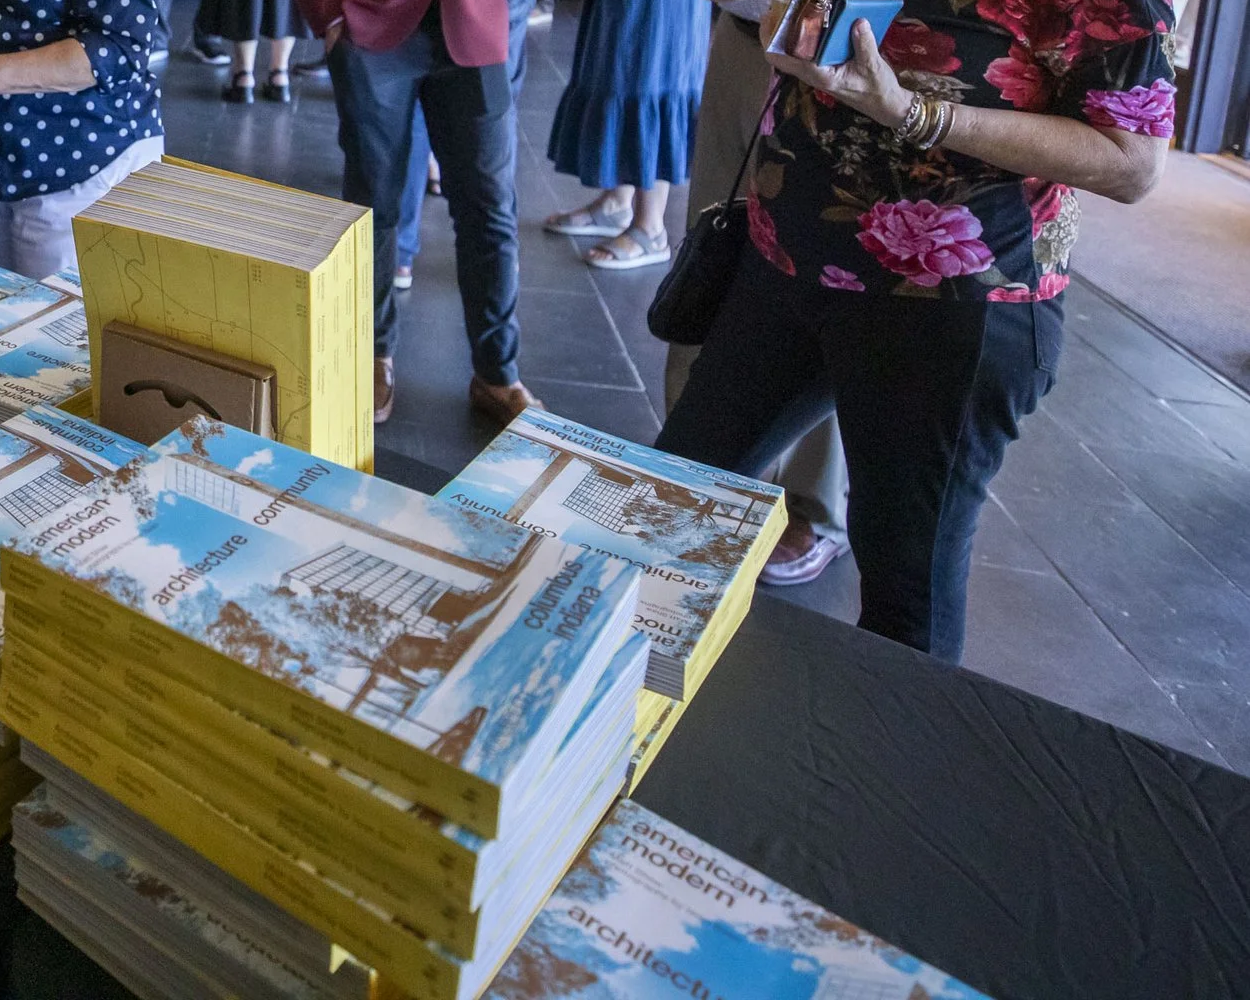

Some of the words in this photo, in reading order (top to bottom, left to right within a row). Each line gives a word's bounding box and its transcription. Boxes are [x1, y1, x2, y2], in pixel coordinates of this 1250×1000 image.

[26, 350, 91, 375] rchitecture
[3, 382, 52, 401] modern
[32, 418, 105, 454] columbus
[61, 419, 116, 446] indiana
[535, 422, 623, 459] columbus
[563, 423, 627, 453] indiana
[254, 462, 332, 527] community
[451, 492, 558, 540] community
[31, 497, 111, 549] american
[51, 515, 121, 558] modern
[152, 534, 249, 607] architecture
[524, 558, 584, 632] columbus
[555, 585, 602, 640] indiana
[620, 834, 736, 909] modern
[632, 820, 769, 904] american
[566, 904, 725, 1000] architectu
